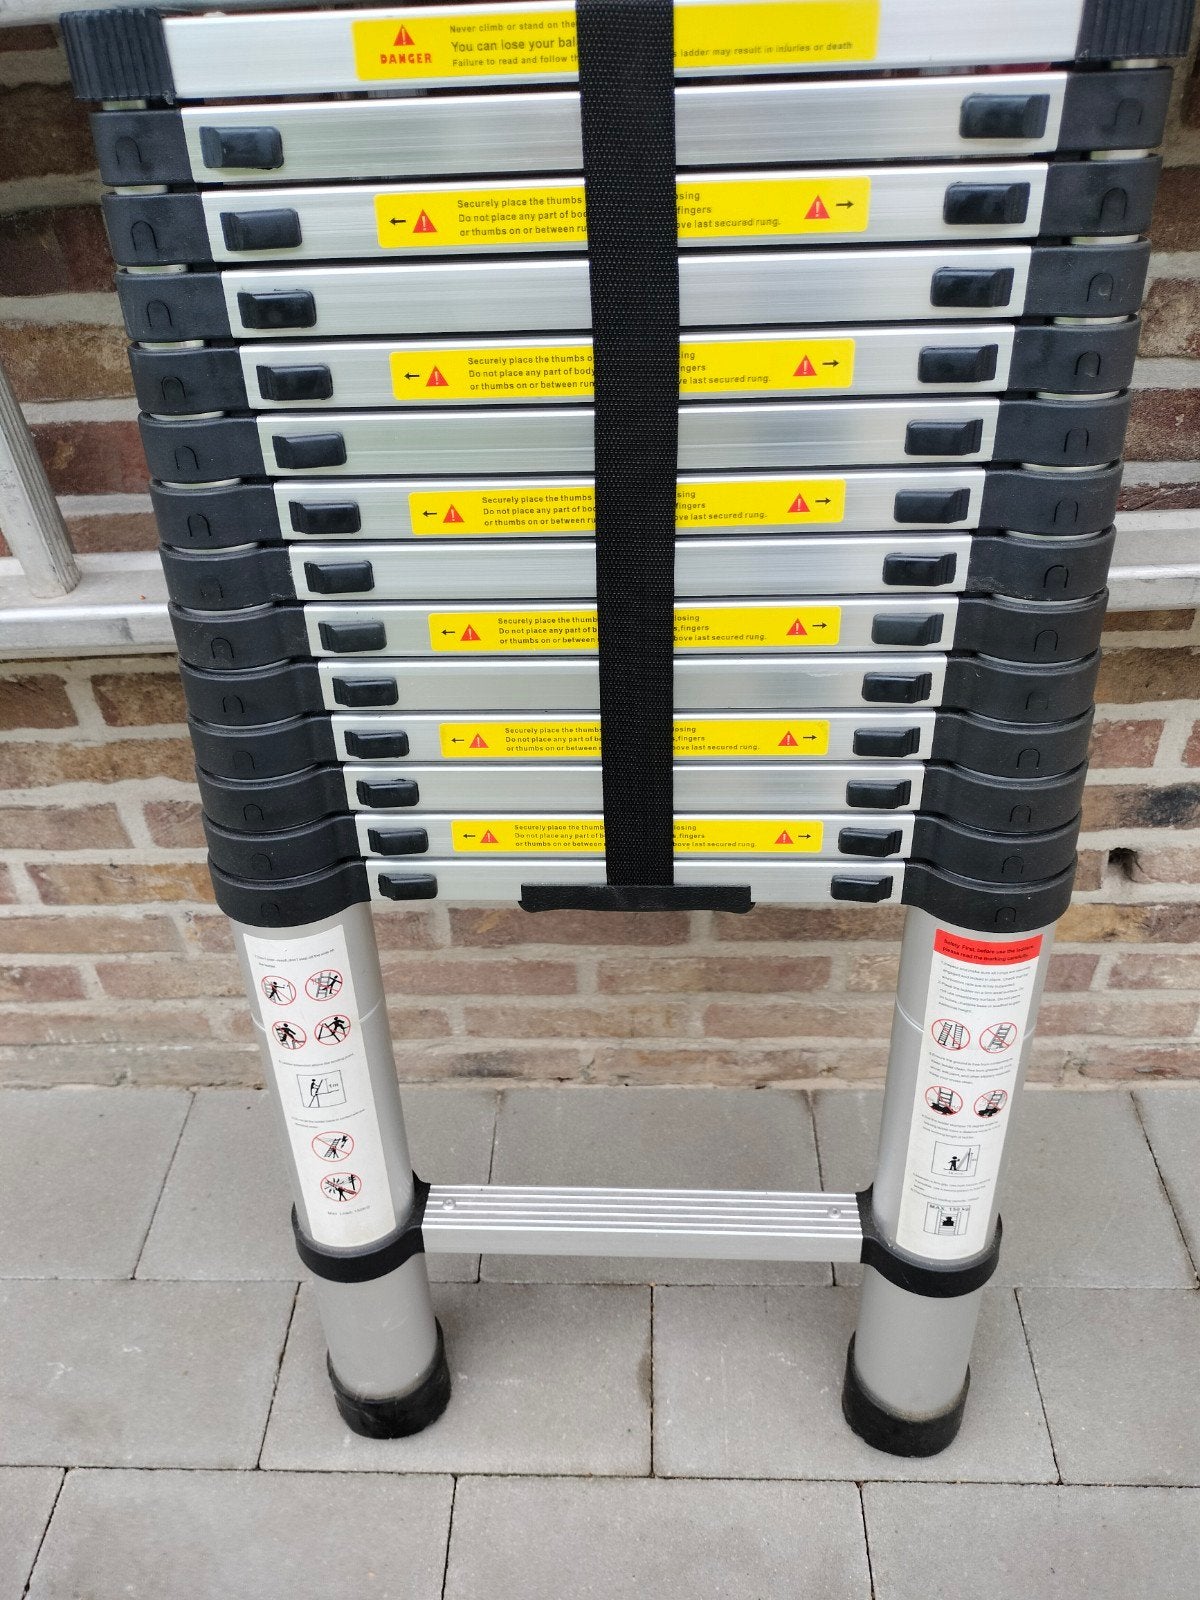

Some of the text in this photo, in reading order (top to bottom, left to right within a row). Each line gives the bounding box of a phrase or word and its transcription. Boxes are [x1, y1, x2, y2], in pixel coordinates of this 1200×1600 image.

[449, 24, 476, 33] Never
[478, 23, 504, 32] climb
[518, 21, 544, 30] stand
[561, 20, 576, 29] the
[450, 34, 576, 53] You can lose your bal
[380, 52, 432, 64] DANGER
[452, 58, 484, 67] Failure
[486, 58, 495, 66] to
[498, 56, 518, 65] read
[520, 55, 537, 64] and
[539, 54, 568, 63] follow
[680, 48, 710, 57] ladder
[711, 48, 731, 57] may
[733, 46, 762, 55] result
[763, 46, 774, 54] in
[775, 43, 812, 53] injuries
[825, 41, 854, 51] death
[457, 198, 499, 209] Securely
[501, 198, 527, 208] place
[528, 196, 545, 206] the
[546, 195, 583, 205] thumbs
[458, 213, 471, 223] Do
[473, 213, 490, 222] not
[491, 212, 517, 223] place
[518, 213, 536, 222] any
[538, 211, 557, 221] part
[559, 209, 569, 220] of
[459, 229, 470, 237] or
[471, 227, 507, 236] thumbs
[522, 227, 533, 235] or
[534, 225, 575, 234] between
[694, 219, 712, 228] last
[714, 218, 753, 228] secured
[755, 218, 782, 228] rung.
[467, 356, 507, 366] Securely
[508, 356, 534, 366] place
[534, 355, 550, 363] the
[550, 354, 585, 363] thumbs
[468, 369, 481, 378] Do
[482, 370, 498, 378] not
[499, 369, 524, 379] place
[525, 369, 541, 378] any
[543, 367, 562, 378] part
[563, 367, 573, 376] of
[481, 381, 514, 390] thumbs
[540, 380, 577, 389] between
[689, 376, 707, 384] last
[708, 375, 745, 384] secured
[747, 375, 771, 384] rung.
[481, 490, 696, 504] Securely place the thumbs sing
[483, 507, 495, 515] Do
[511, 507, 535, 516] place
[536, 507, 551, 515] any
[552, 506, 570, 515] part
[571, 505, 581, 513] of
[494, 518, 526, 526] thumbs
[550, 517, 585, 525] between
[690, 513, 707, 521] last
[708, 511, 743, 520] secured
[744, 512, 767, 520] rung.
[497, 614, 700, 625] Securely place the thumb losing
[525, 627, 547, 635] place
[564, 627, 581, 635] part
[711, 633, 744, 641] secured
[504, 727, 538, 735] Securely
[531, 736, 552, 744] place
[568, 736, 583, 744] part
[673, 824, 697, 832] losing
